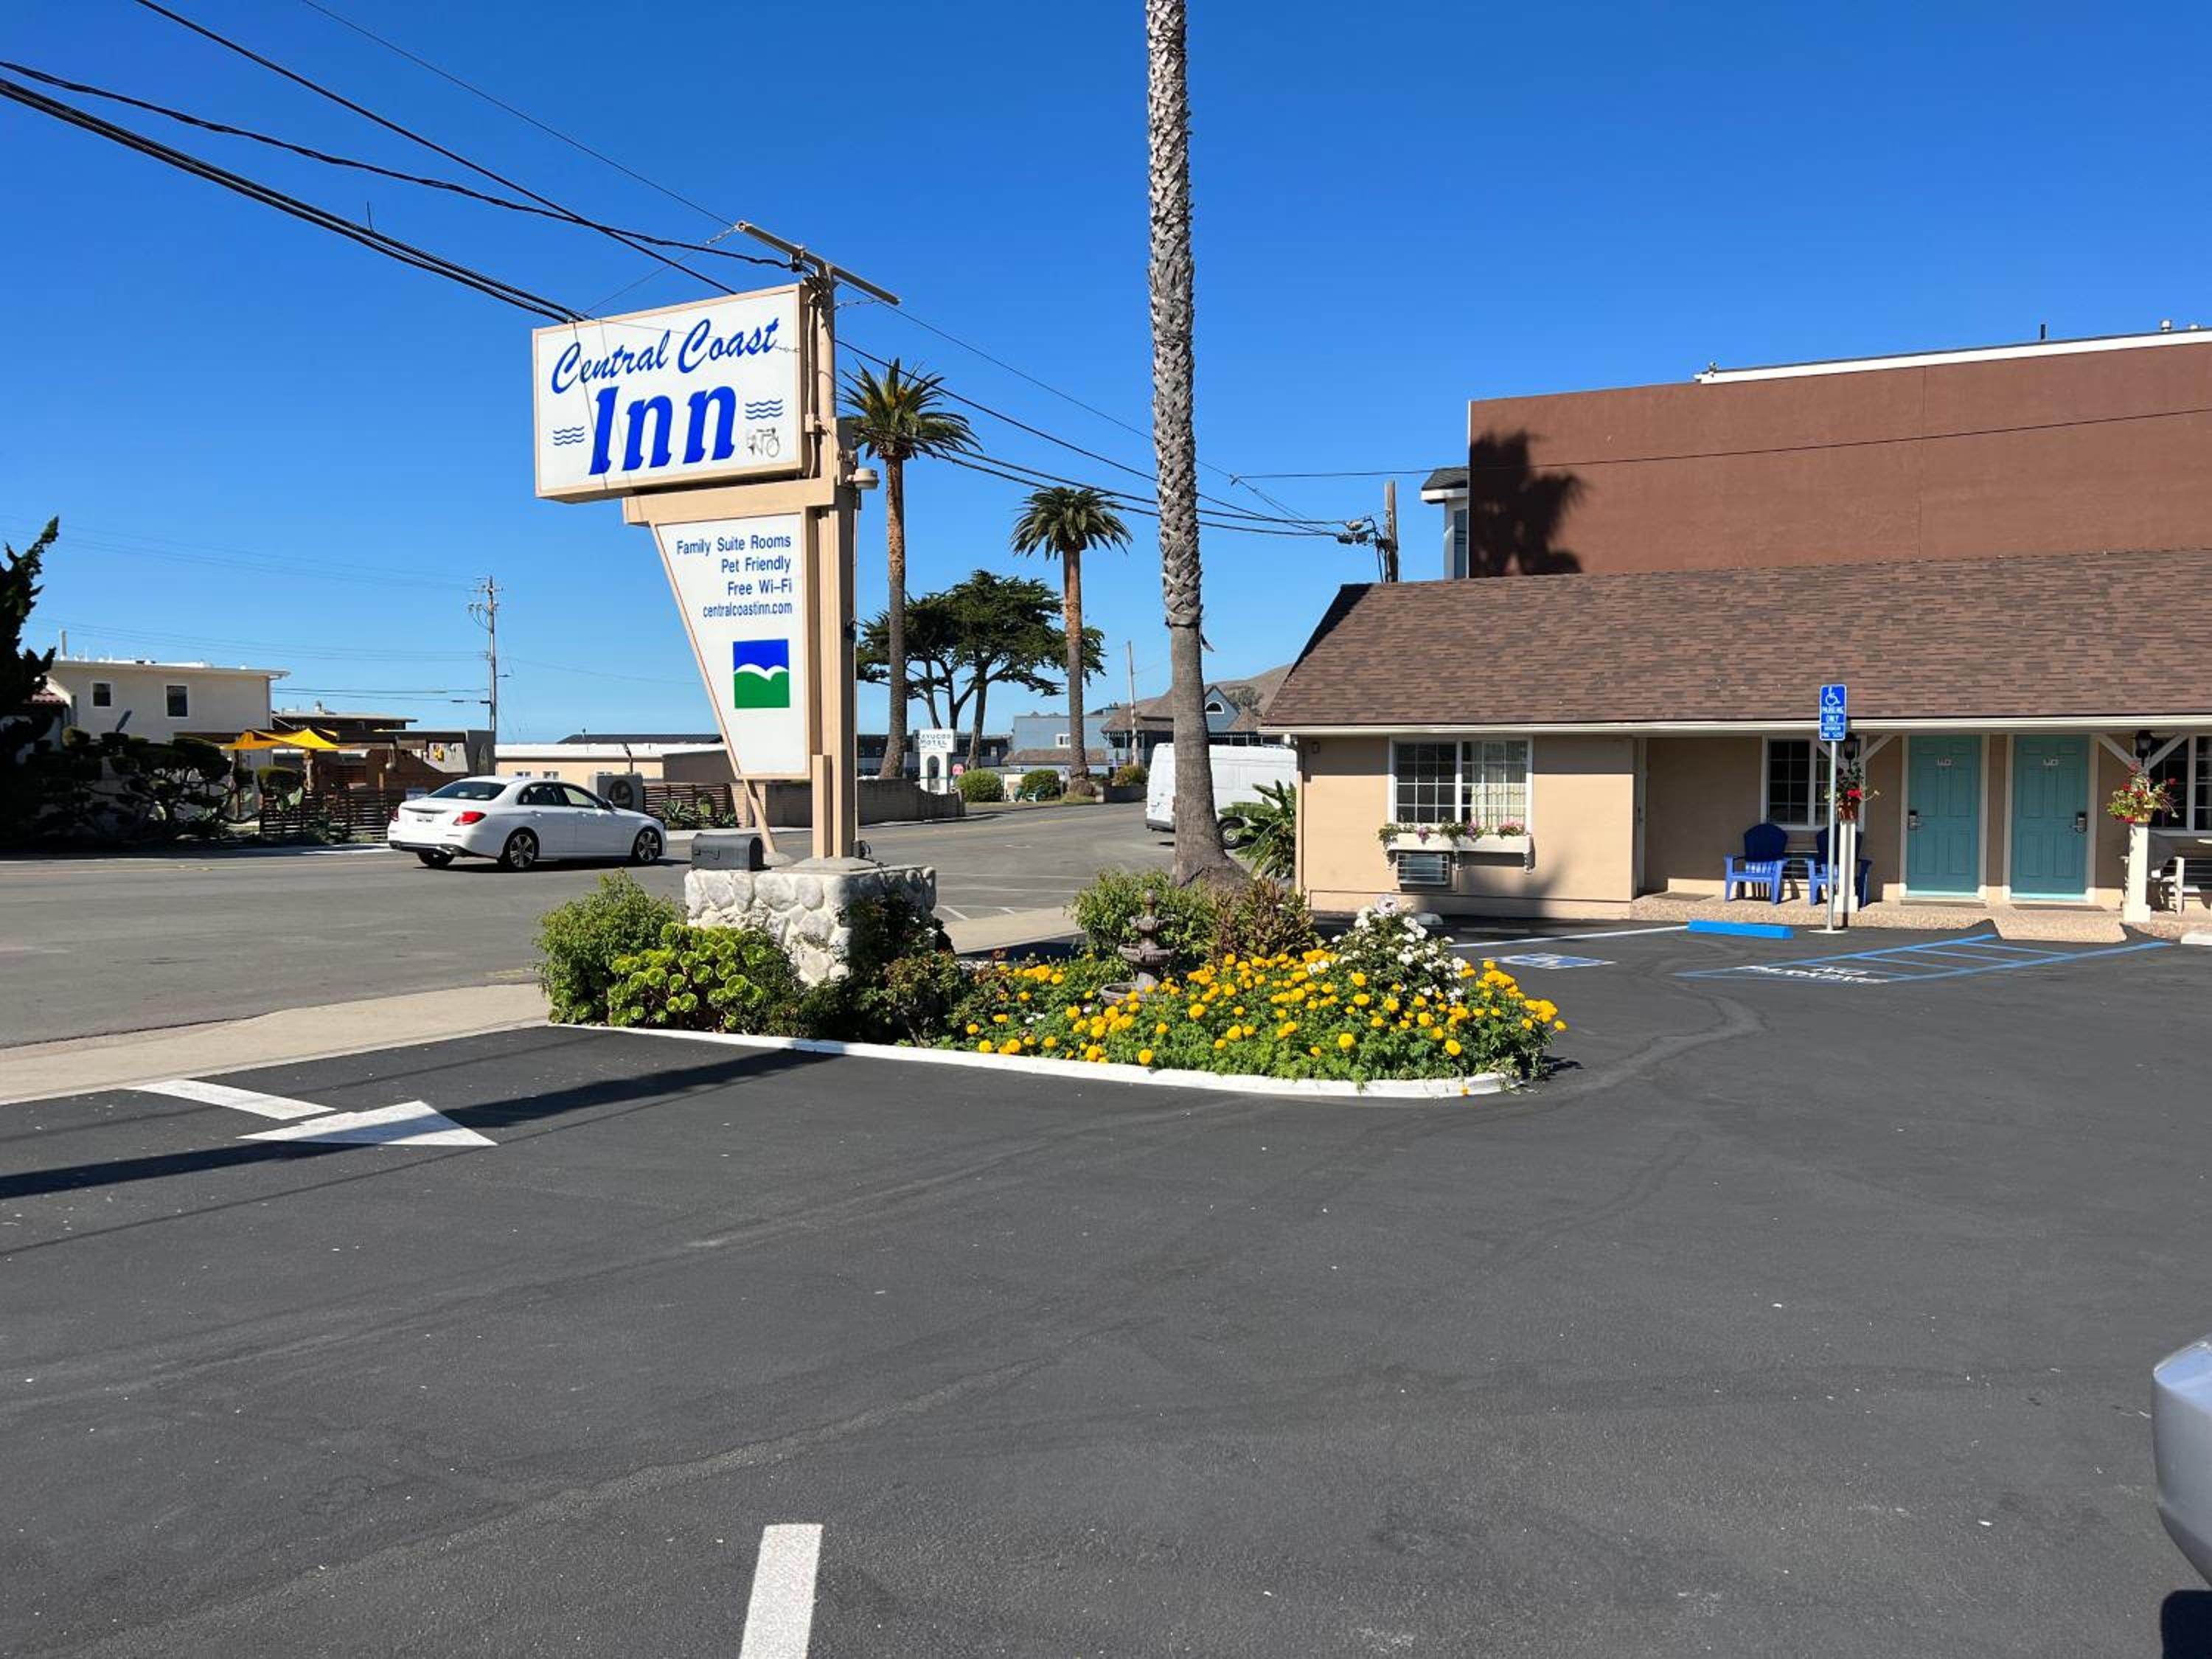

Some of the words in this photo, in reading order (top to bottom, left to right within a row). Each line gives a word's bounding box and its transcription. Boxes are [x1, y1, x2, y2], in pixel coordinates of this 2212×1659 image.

[551, 329, 671, 394] Central
[678, 318, 779, 374] Coast
[588, 386, 737, 476] Inn
[676, 540, 711, 556] Family
[717, 537, 745, 552] Suite
[751, 535, 791, 549] Rooms
[721, 558, 740, 573] Pet
[745, 555, 791, 573] Friendly
[728, 582, 753, 596] Free
[759, 578, 792, 594] Wi-Fi
[703, 602, 793, 618] centralcoastinn.com
